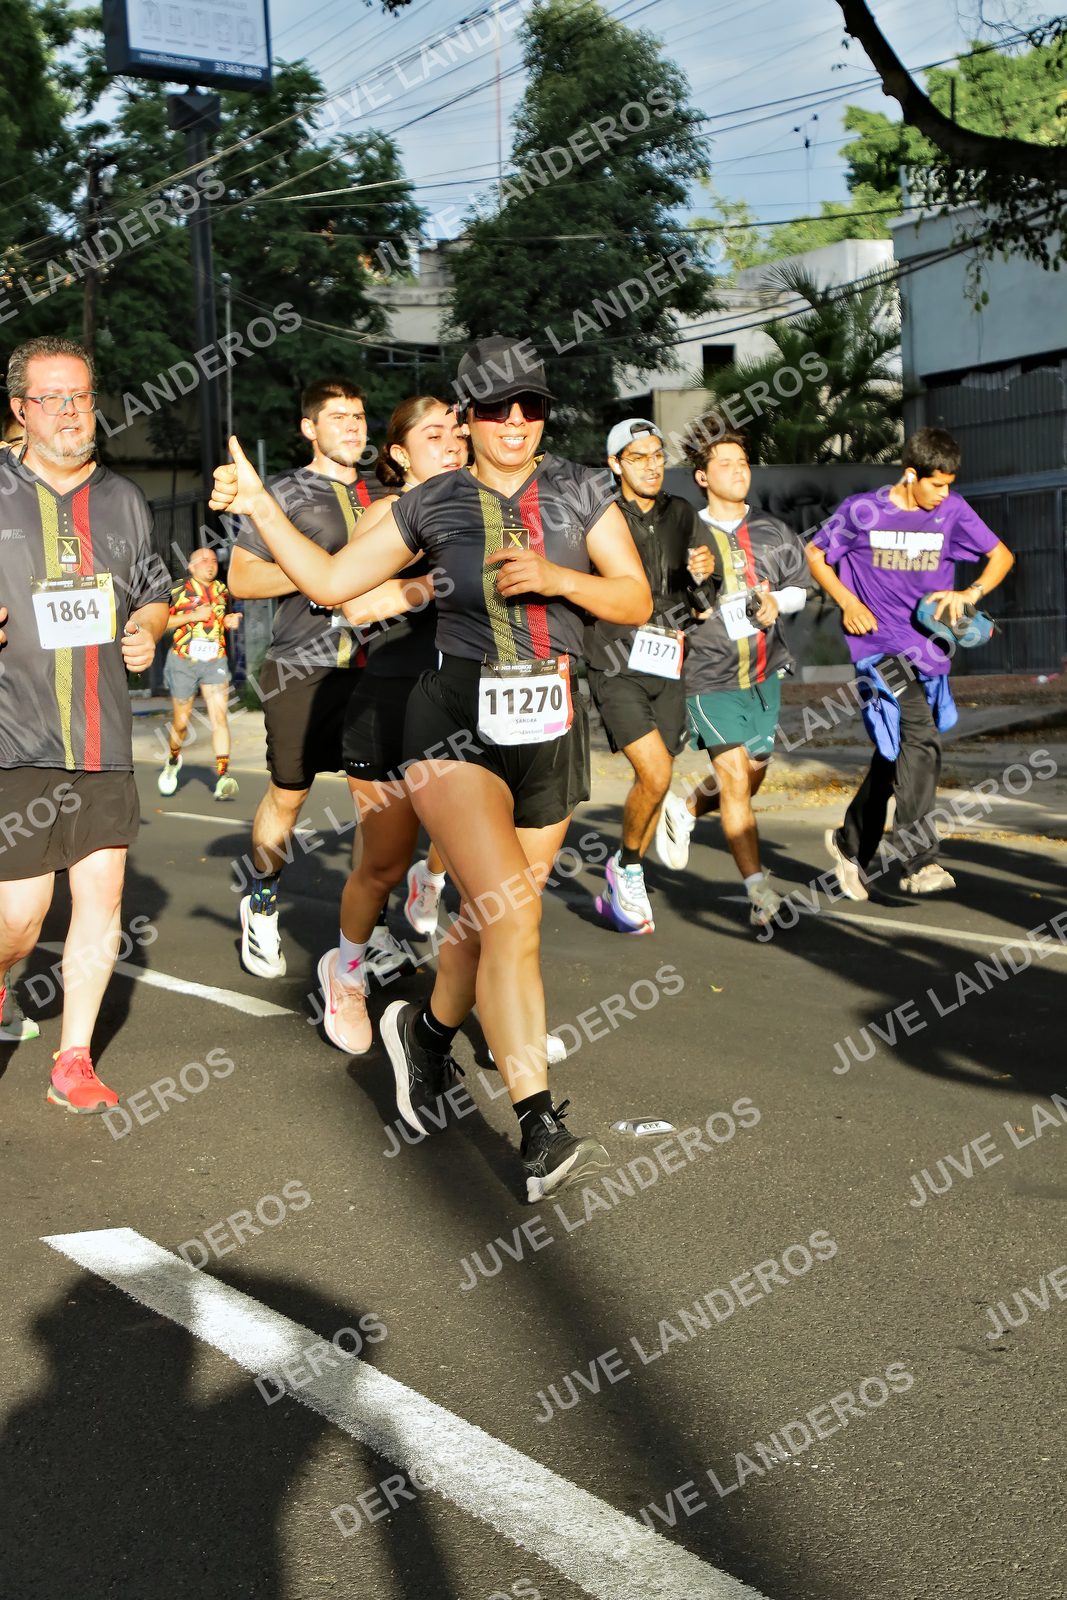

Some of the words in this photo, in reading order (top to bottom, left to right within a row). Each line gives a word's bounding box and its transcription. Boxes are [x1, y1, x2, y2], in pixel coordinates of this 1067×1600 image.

[47, 599, 99, 622] 1864
[729, 607, 744, 623] 10
[639, 639, 676, 660] 11371
[485, 684, 563, 715] 11270
